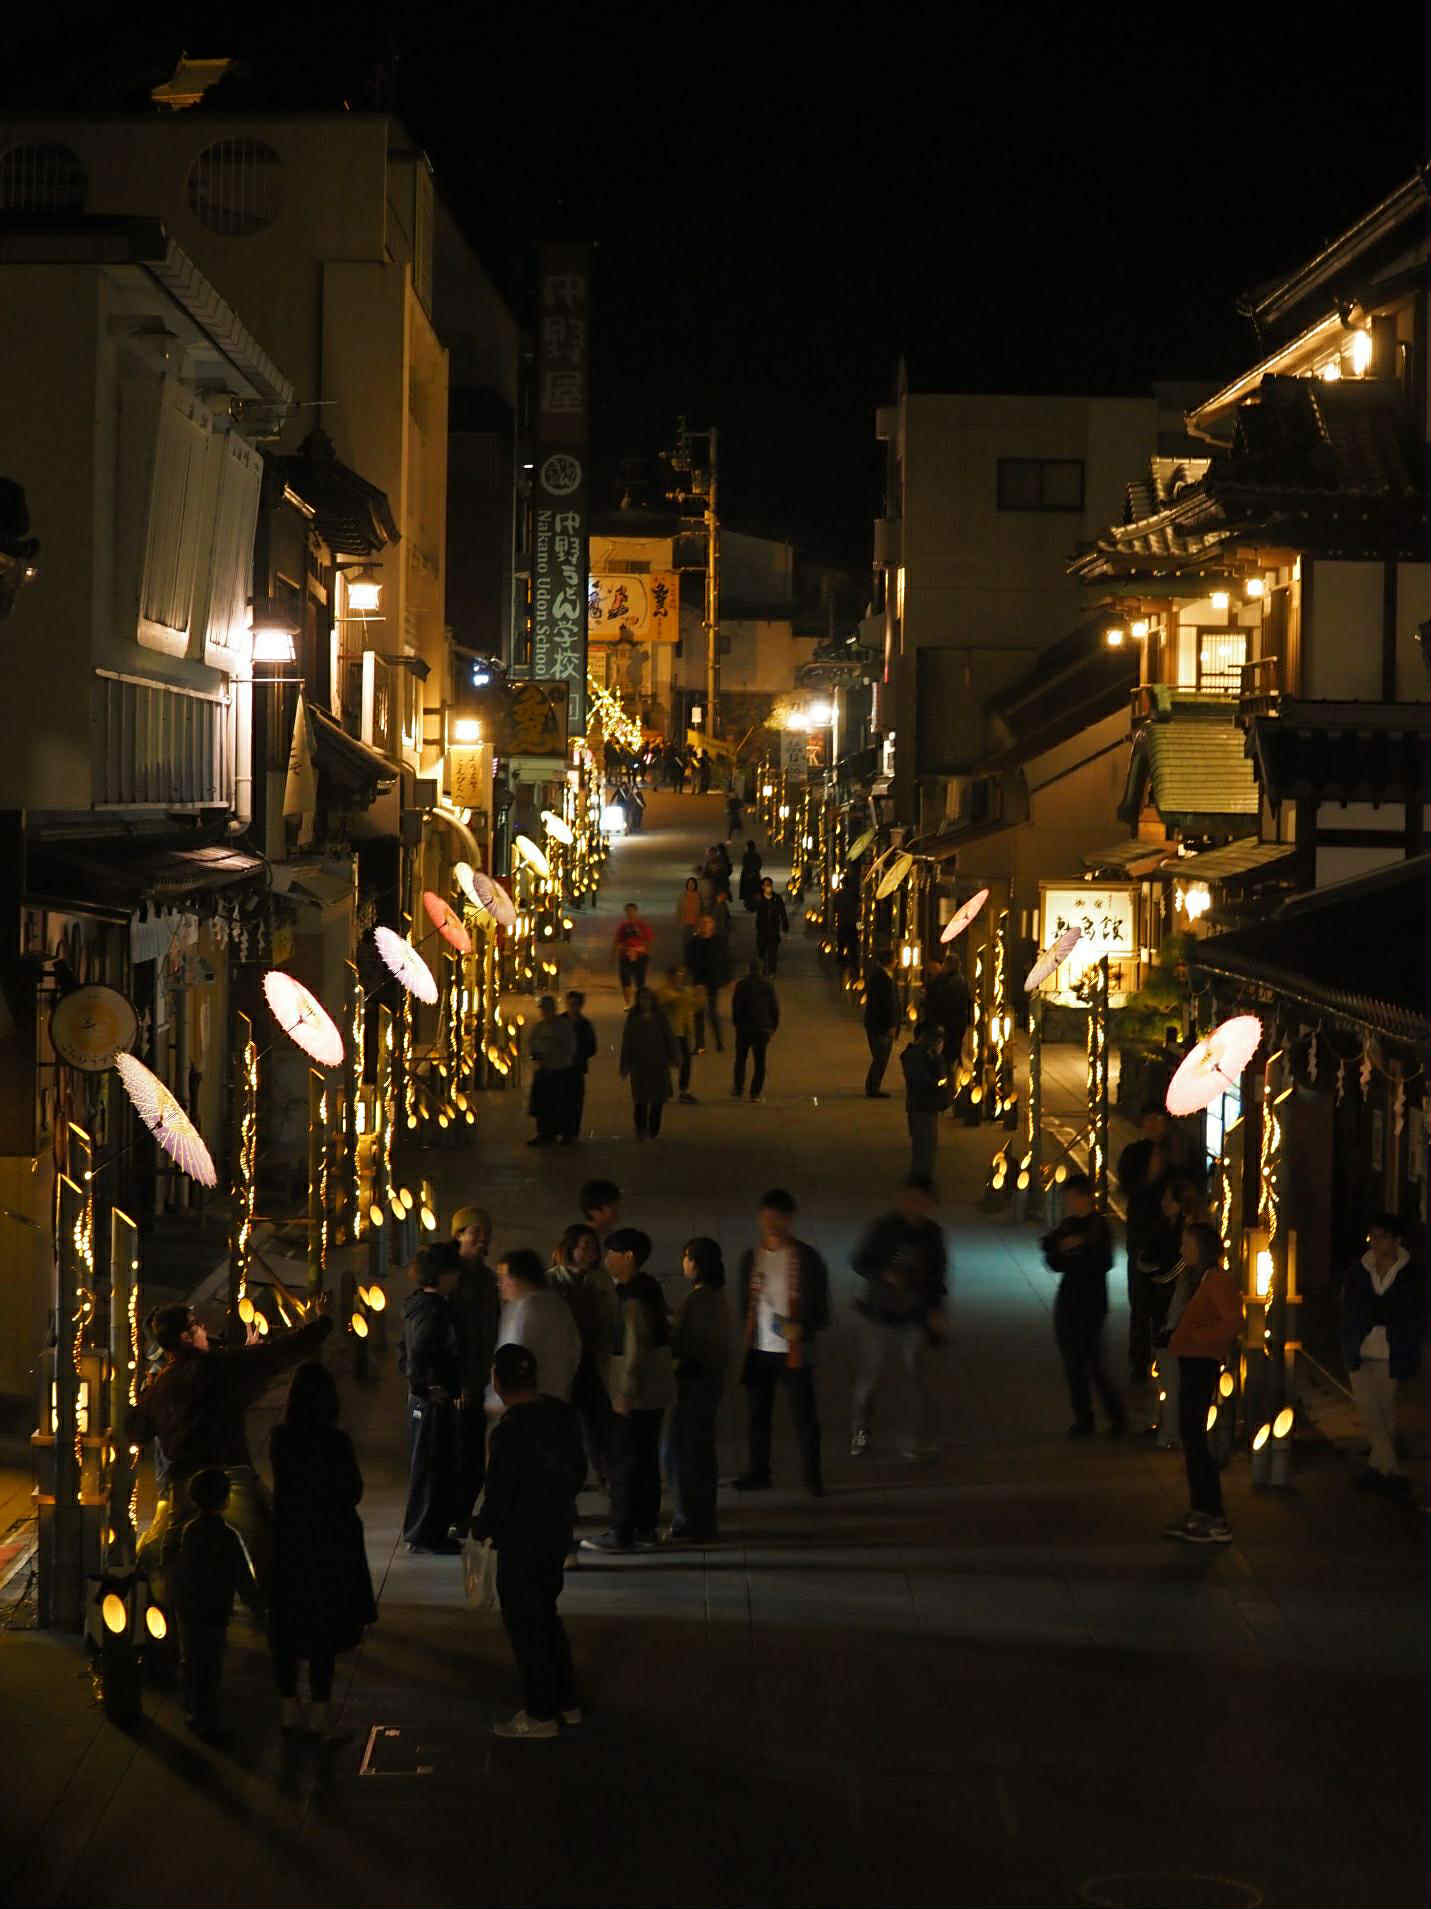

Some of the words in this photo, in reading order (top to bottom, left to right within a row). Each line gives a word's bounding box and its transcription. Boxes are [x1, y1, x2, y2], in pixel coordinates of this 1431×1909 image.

[543, 271, 584, 416] 中野屋
[537, 510, 551, 573] Nakano
[537, 578, 551, 621] Udon
[551, 511, 582, 680] 中野うどん学校
[537, 624, 551, 680] School
